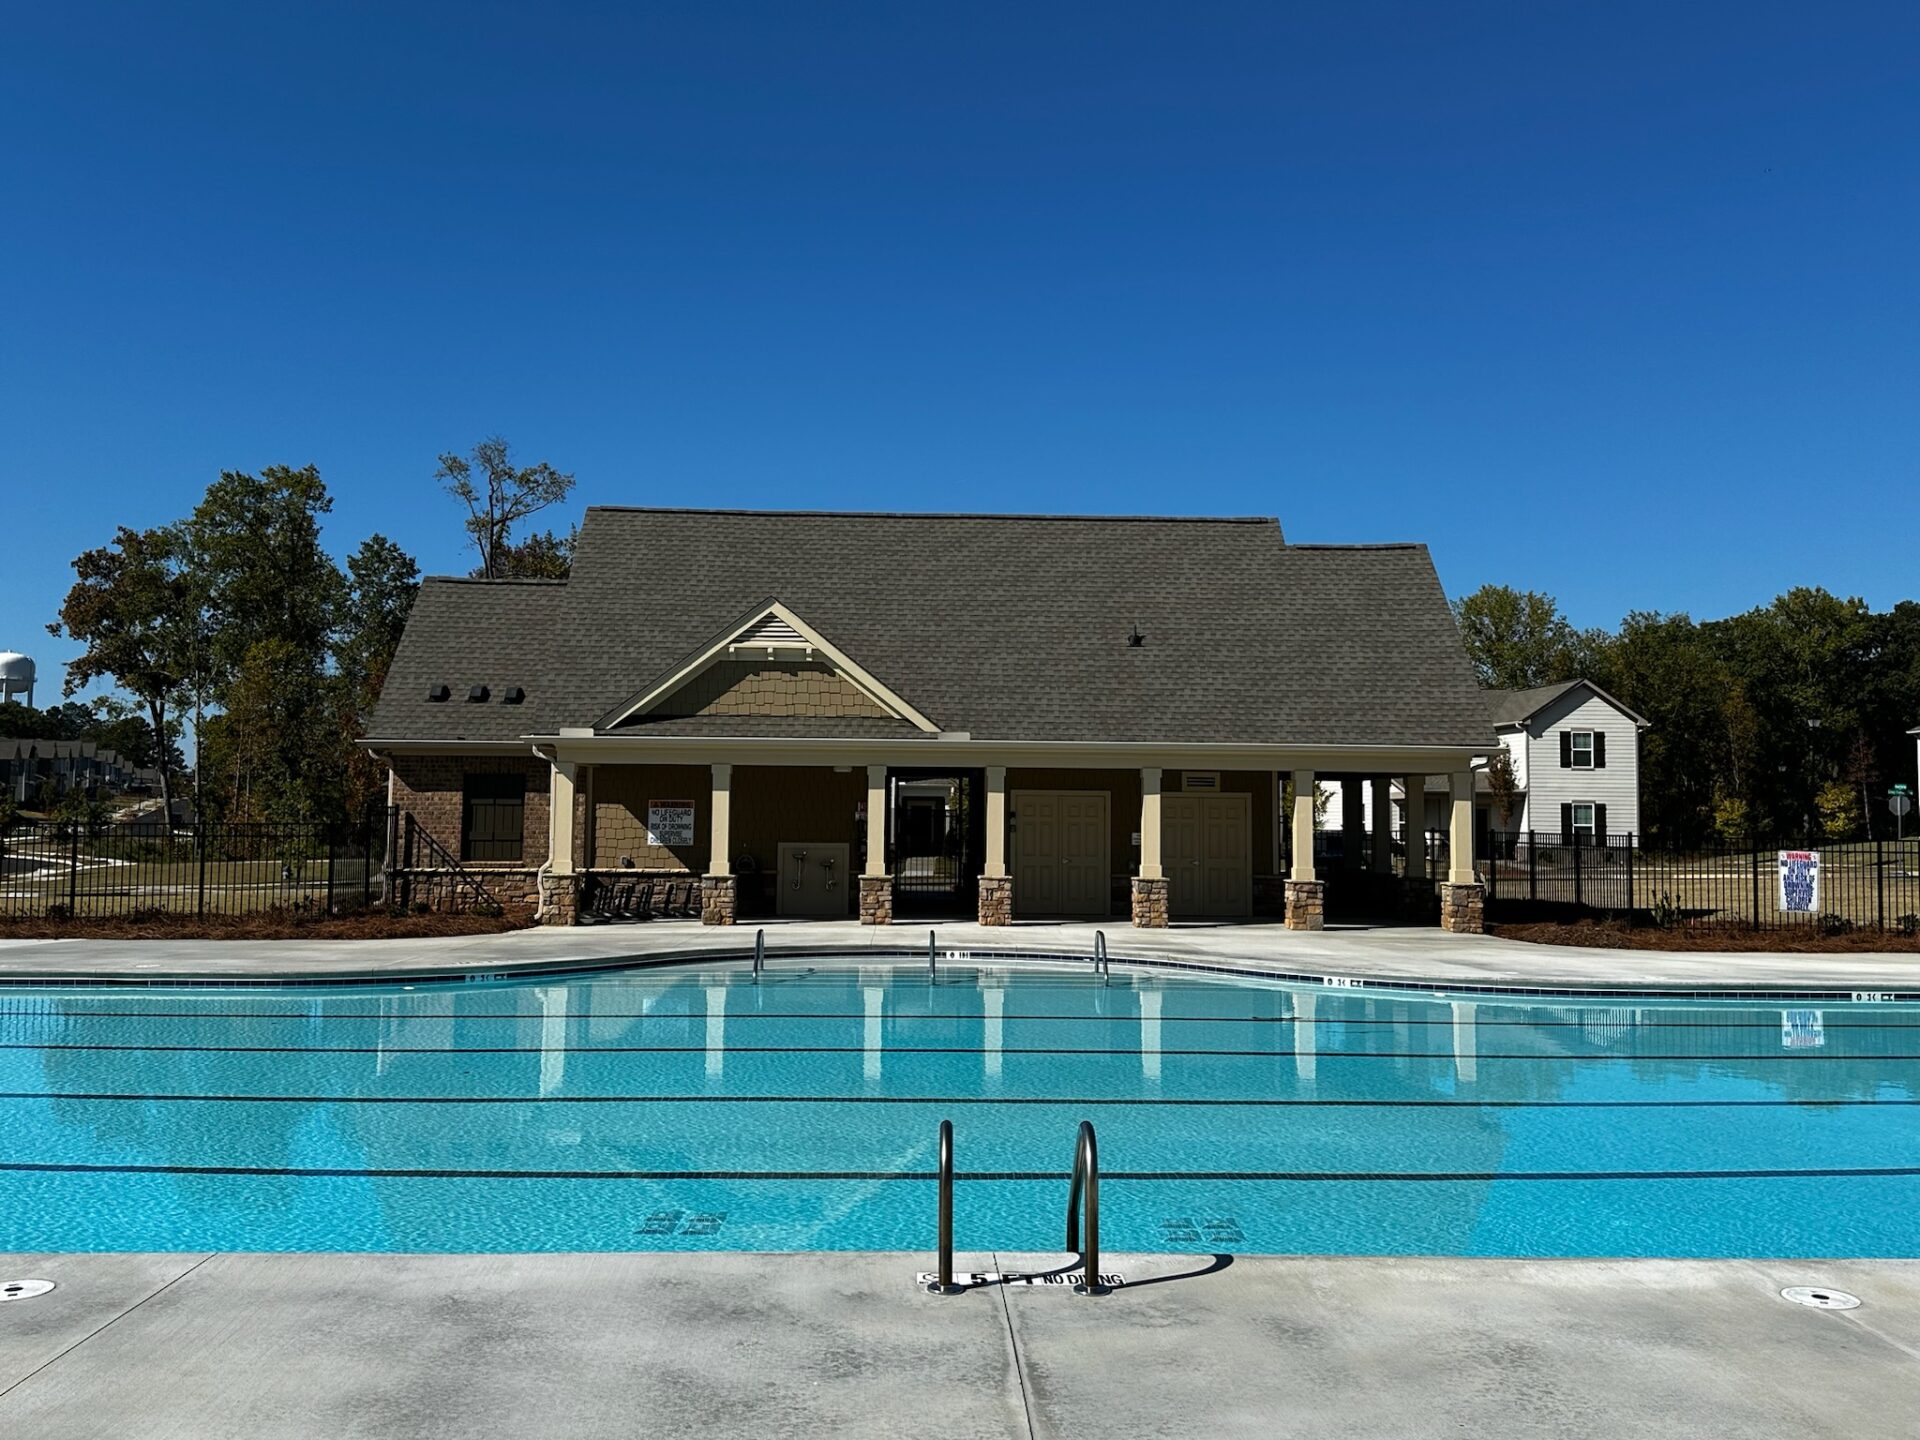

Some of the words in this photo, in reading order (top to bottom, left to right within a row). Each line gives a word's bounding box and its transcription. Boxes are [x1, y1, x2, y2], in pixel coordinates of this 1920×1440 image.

[661, 809, 692, 817] LIFEGUARD
[669, 814, 683, 822] DUTY
[1787, 852, 1811, 861] WARNING
[1789, 860, 1817, 869] LIFEGUARD
[970, 1273, 988, 1285] 5
[1001, 1273, 1037, 1285] FT
[1043, 1274, 1064, 1285] NO
[1067, 1274, 1124, 1285] DING
